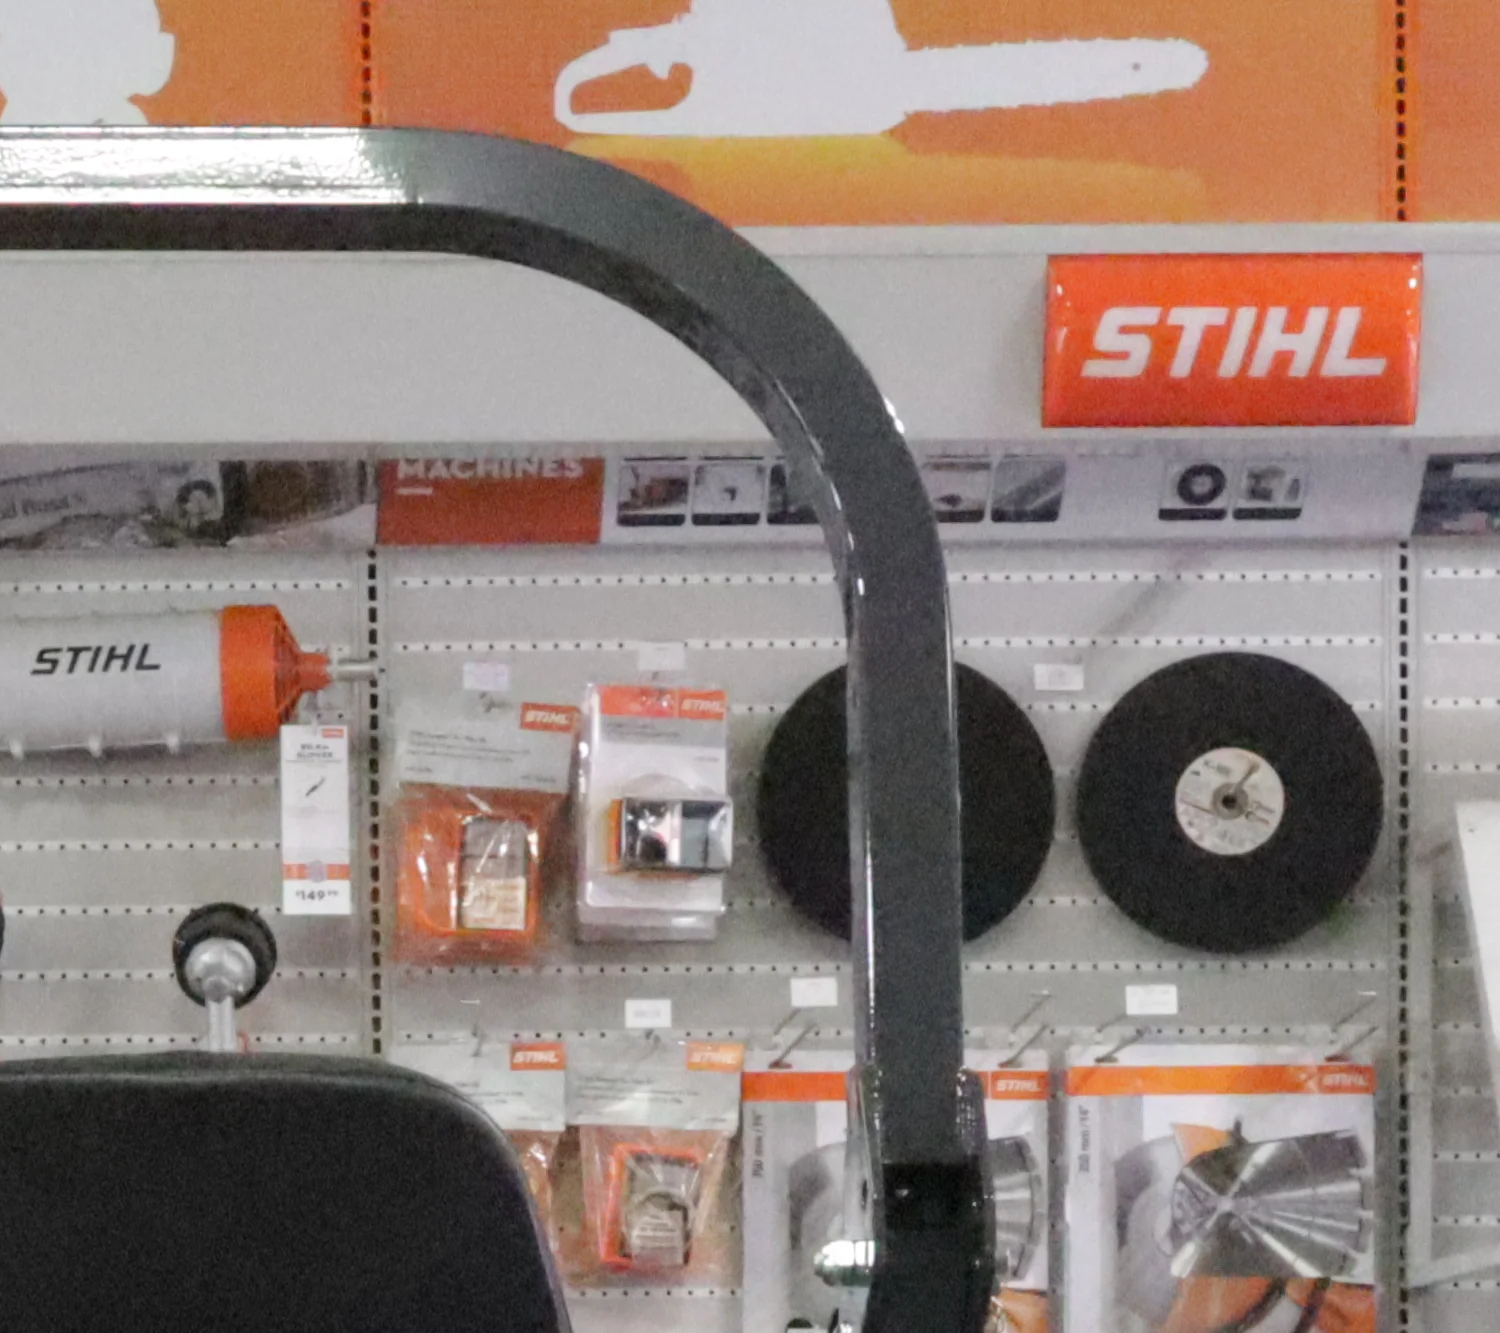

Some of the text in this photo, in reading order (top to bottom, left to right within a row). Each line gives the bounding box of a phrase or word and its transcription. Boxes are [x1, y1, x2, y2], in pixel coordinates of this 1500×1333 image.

[1081, 306, 1387, 378] STIHL
[397, 458, 584, 480] MACHINES
[30, 642, 161, 676] STIHL
[524, 710, 572, 725] STIHL
[513, 1050, 559, 1065] STIHL
[996, 1078, 1041, 1092] STIHL
